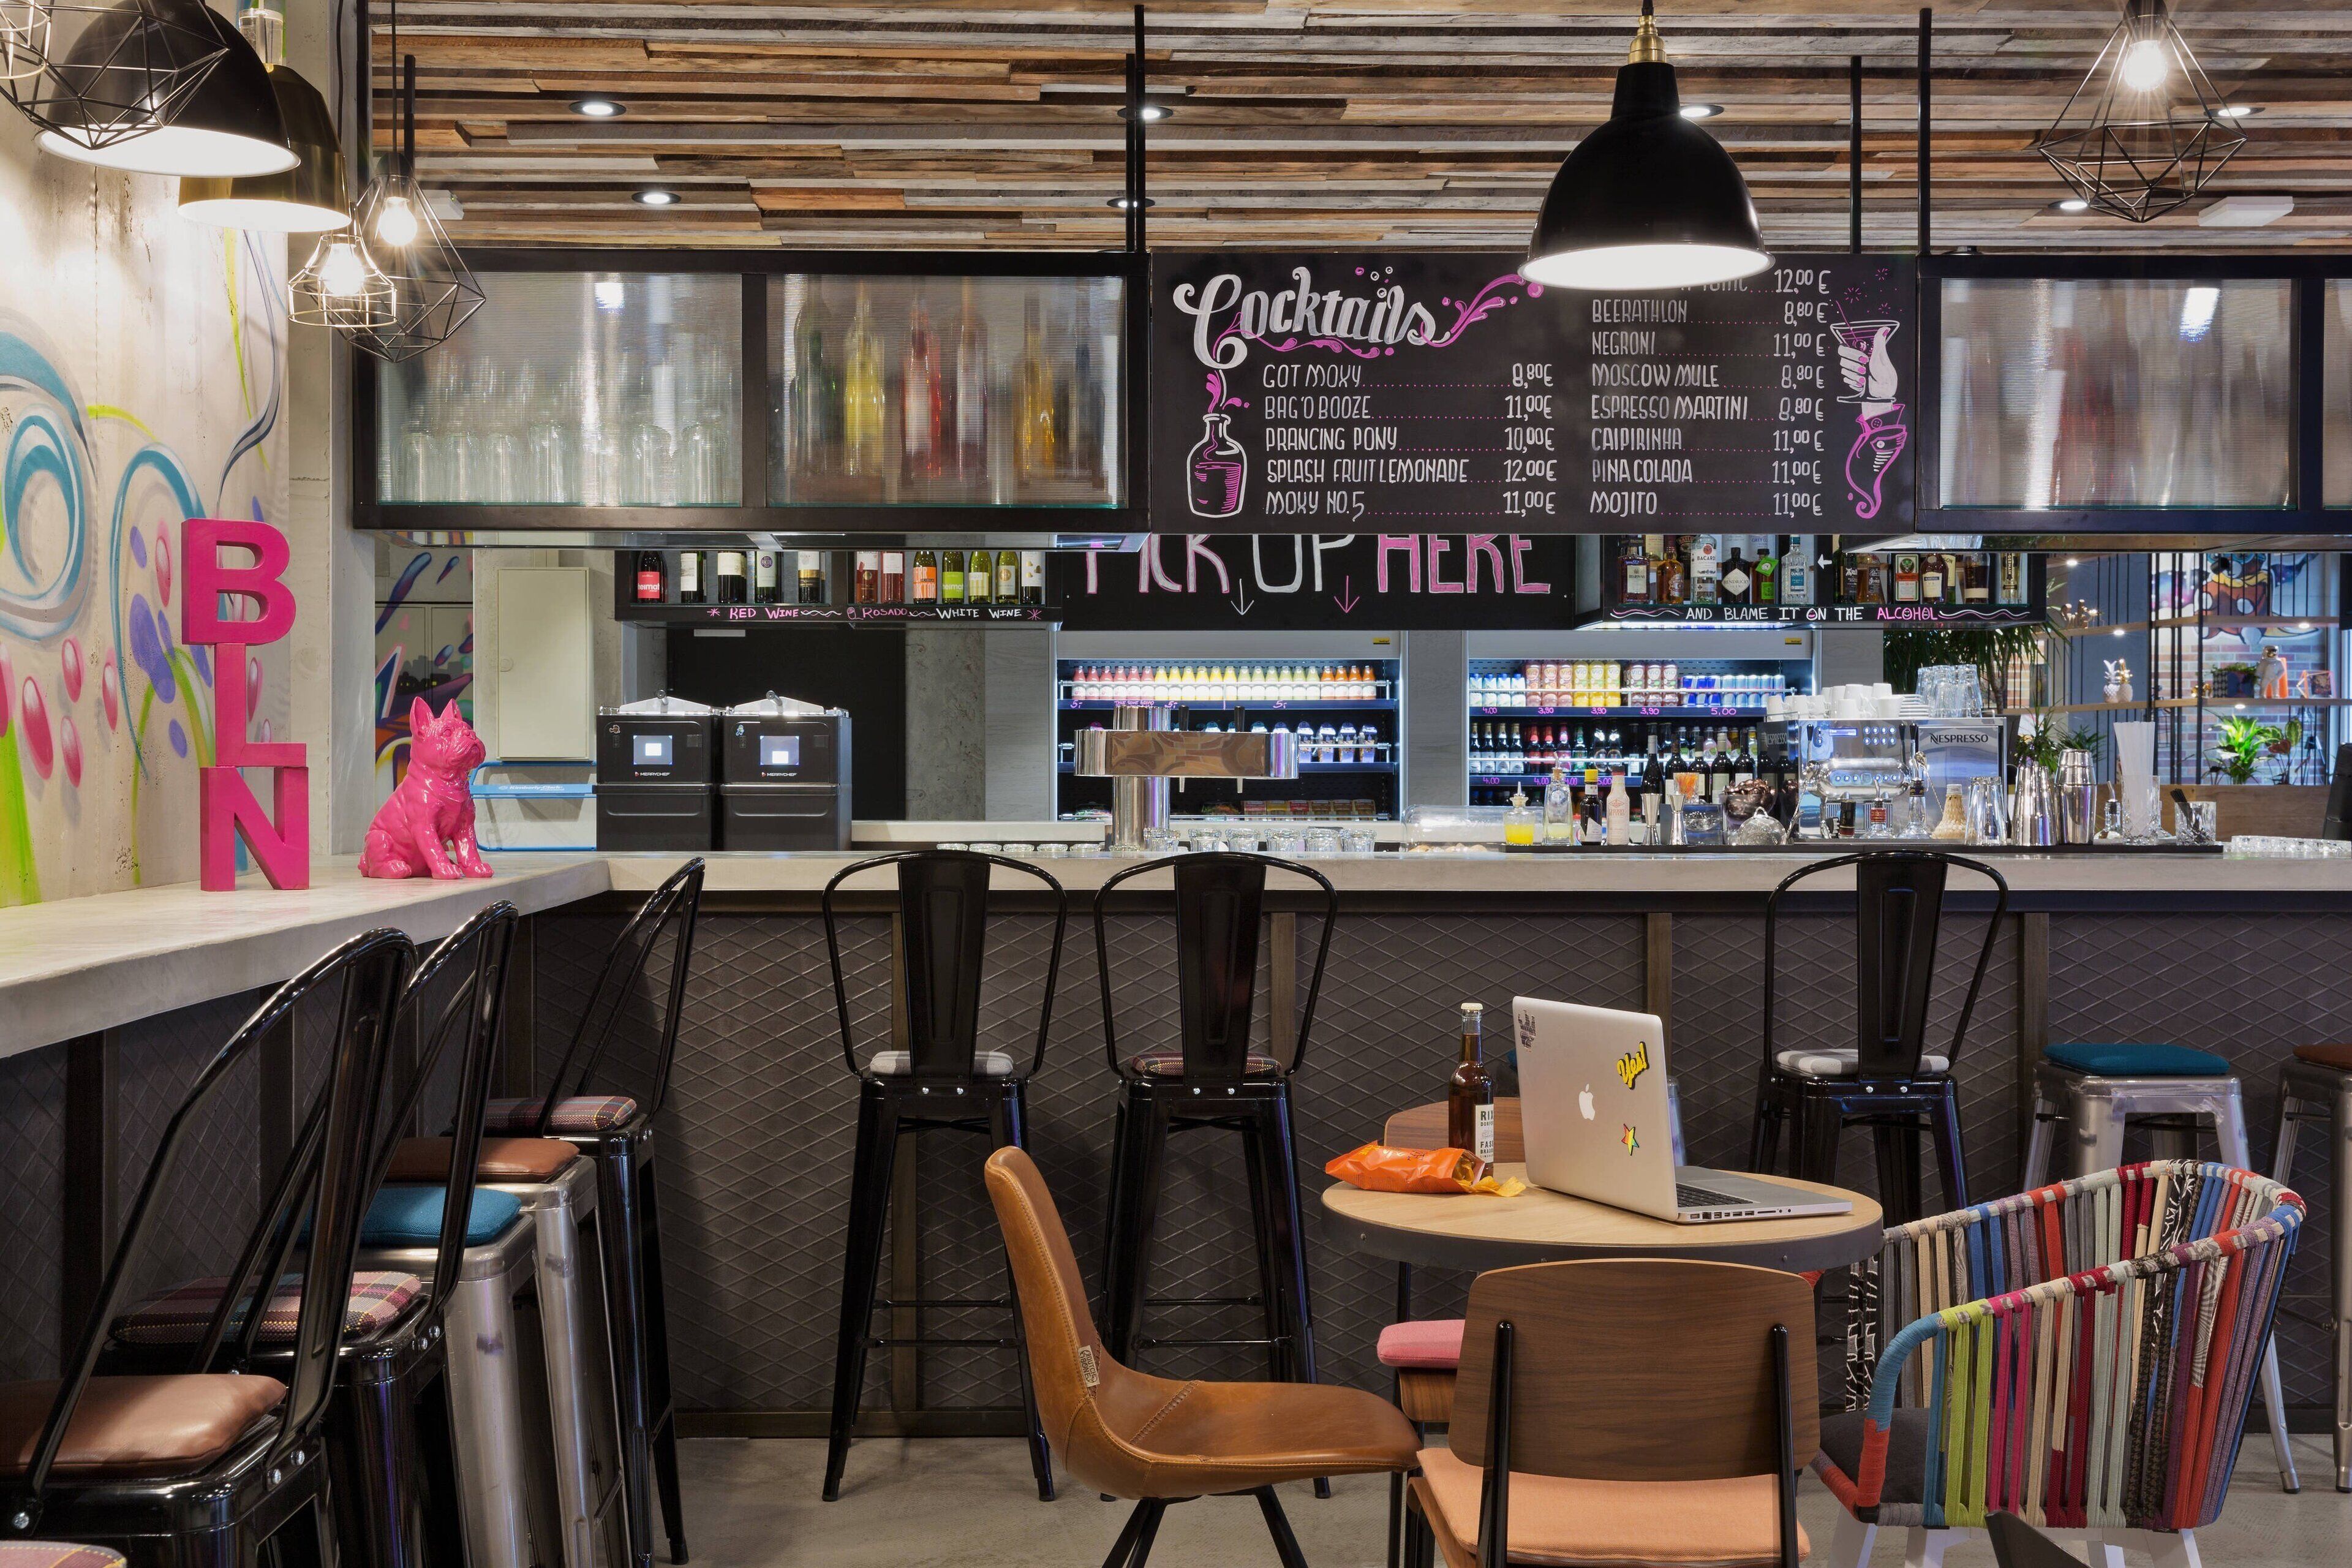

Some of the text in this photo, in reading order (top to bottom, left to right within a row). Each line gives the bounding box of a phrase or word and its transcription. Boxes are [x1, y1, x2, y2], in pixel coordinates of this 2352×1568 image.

[1173, 266, 1450, 369] Cocktails
[1593, 300, 1687, 323] BEERATHLON
[1592, 331, 1656, 355] NEGRONI
[1263, 364, 1302, 388] GOT
[1305, 364, 1361, 388] MOXY
[1592, 363, 1671, 386] MOSCOW
[1675, 364, 1719, 387] MULE
[1318, 396, 1371, 419] BOOZE
[1591, 395, 1670, 419] ESPRESSO
[1673, 396, 1748, 420] MARTINI
[1265, 428, 1345, 451] PRANCING
[1354, 427, 1397, 450] PONY
[1592, 428, 1682, 451] CAIPIRINHA
[1267, 459, 1325, 483] SPLASH
[1334, 459, 1376, 483] FRUIT
[1380, 459, 1469, 483] LEMONADE
[1593, 459, 1631, 483] PINA
[1634, 459, 1693, 483] COLADA
[1265, 491, 1319, 514] MOXY
[1589, 491, 1657, 518] MOJITO
[1253, 534, 1355, 592] UP
[1376, 534, 1551, 593] HERE
[729, 608, 799, 620] RED WINE
[862, 607, 908, 619] ROSADO
[936, 608, 1022, 619] WHITE WINE
[1686, 607, 1938, 621] AND BLAME IT ON THE ALCOHOL
[1929, 733, 1989, 745] NESPRESSO
[1617, 1041, 1649, 1090] Yes!
[1080, 1357, 1091, 1379] BONE
[1086, 1355, 1097, 1377] DUTCH
